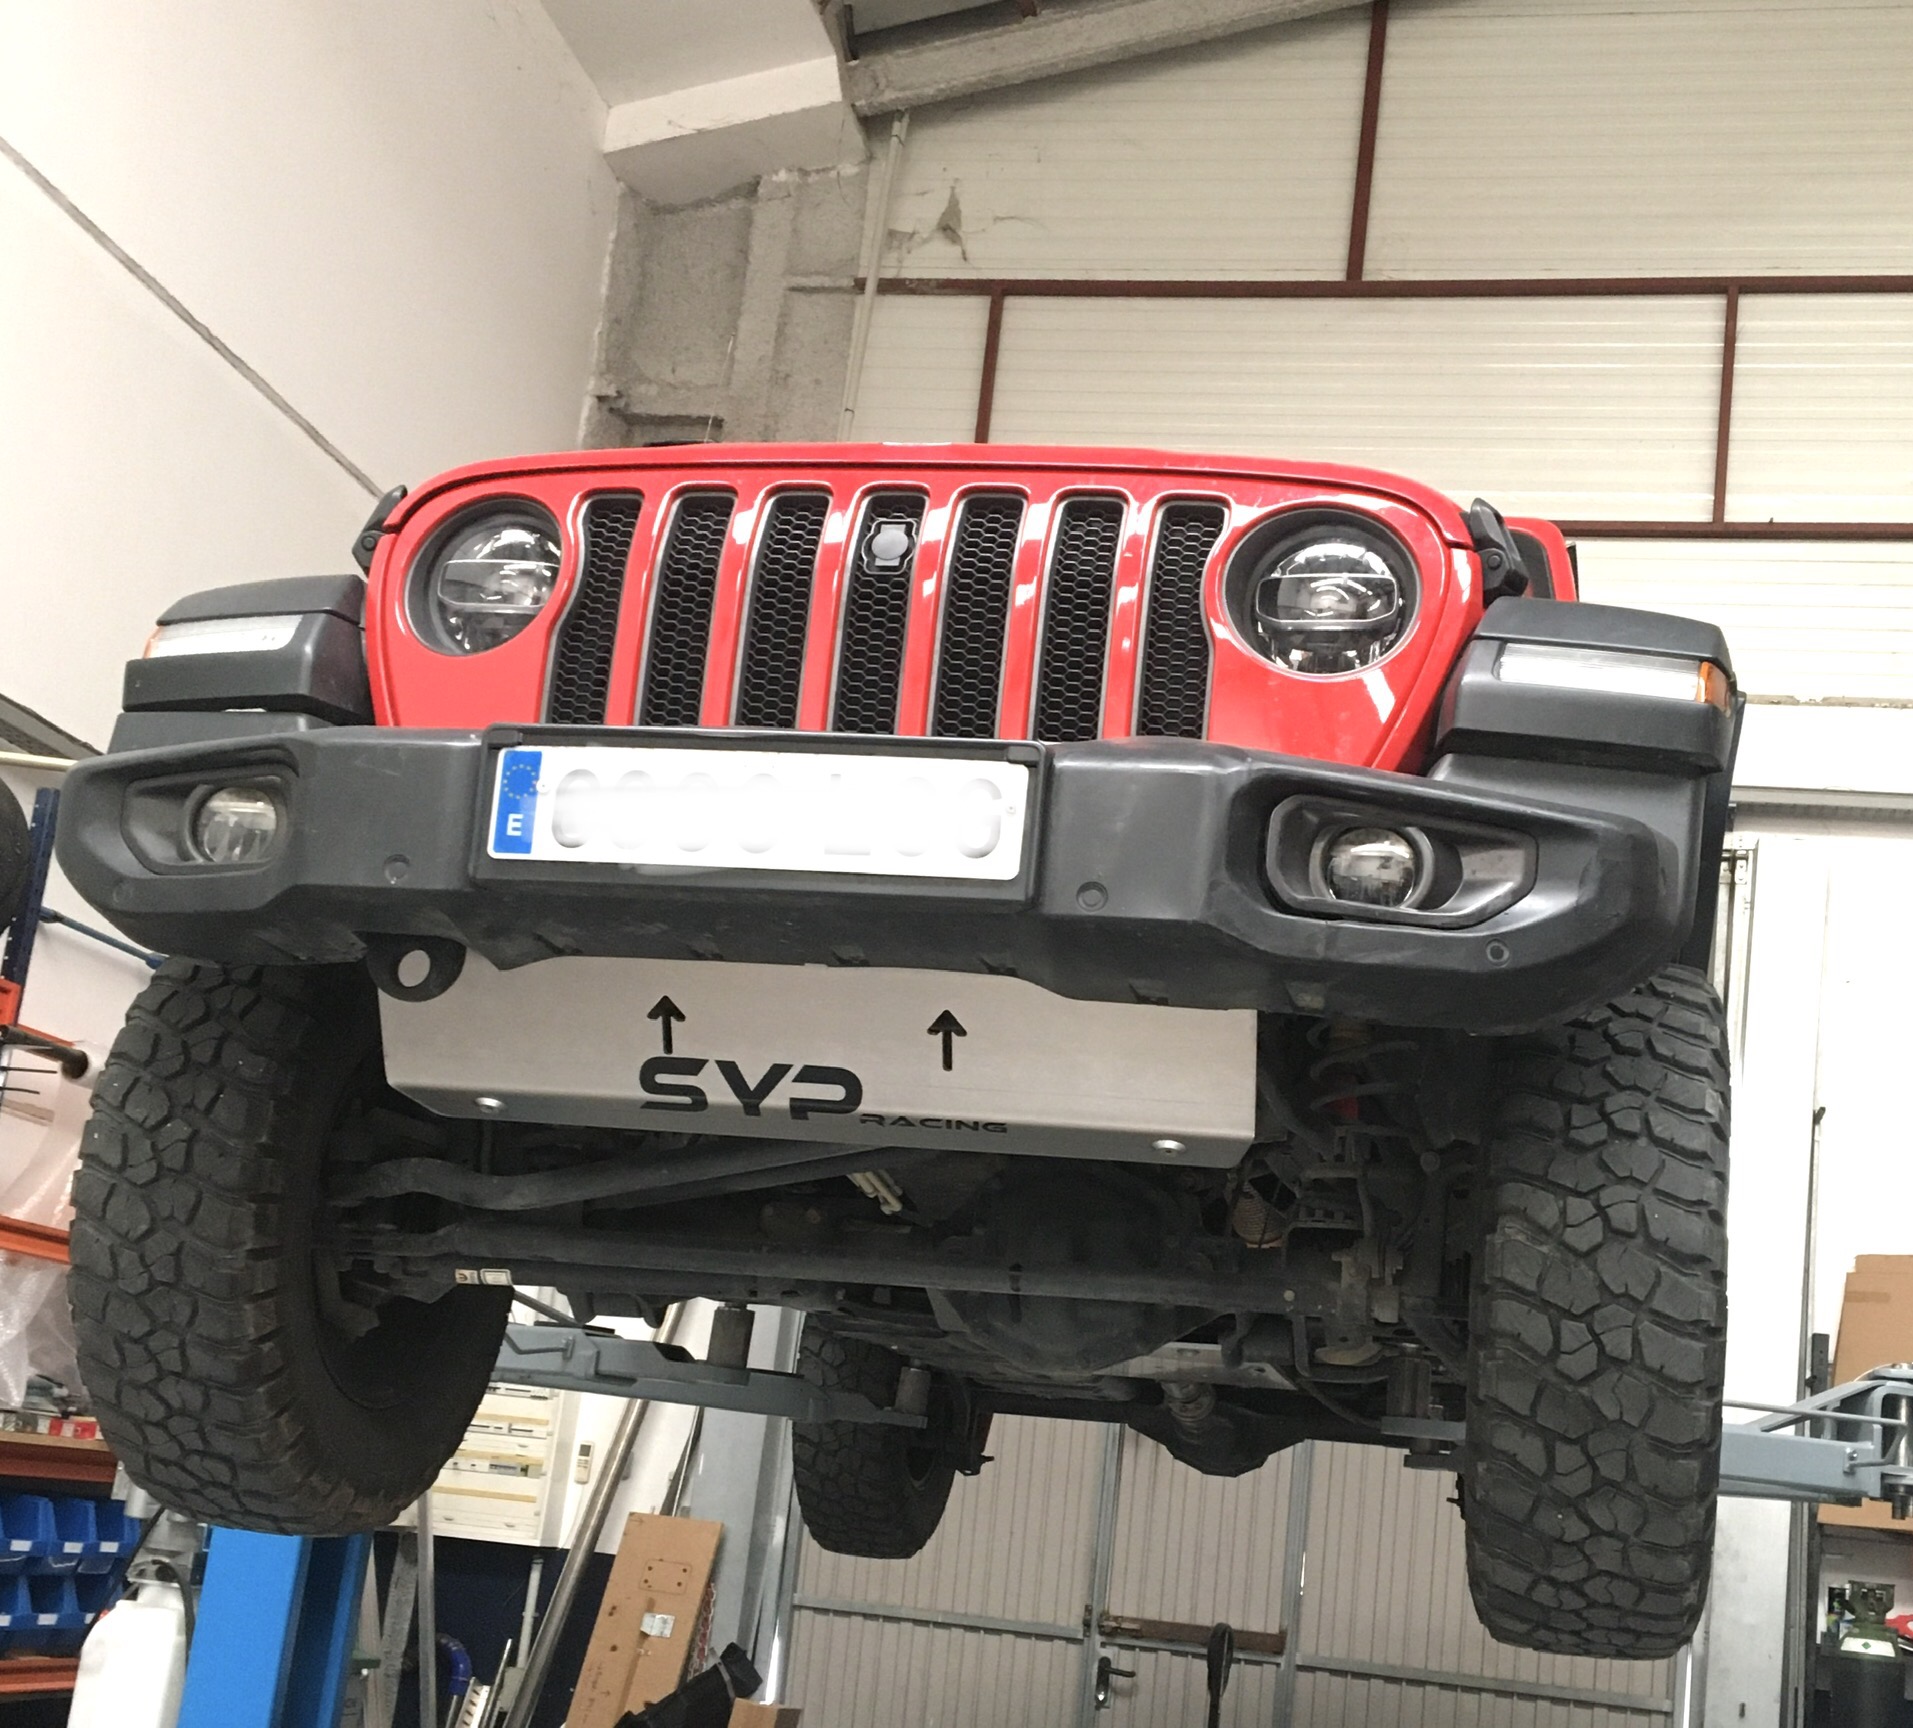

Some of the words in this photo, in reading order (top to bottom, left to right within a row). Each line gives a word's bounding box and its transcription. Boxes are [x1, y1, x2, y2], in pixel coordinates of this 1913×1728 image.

[506, 813, 524, 836] E
[639, 1055, 863, 1120] SYP
[859, 1112, 1008, 1134] RACING
